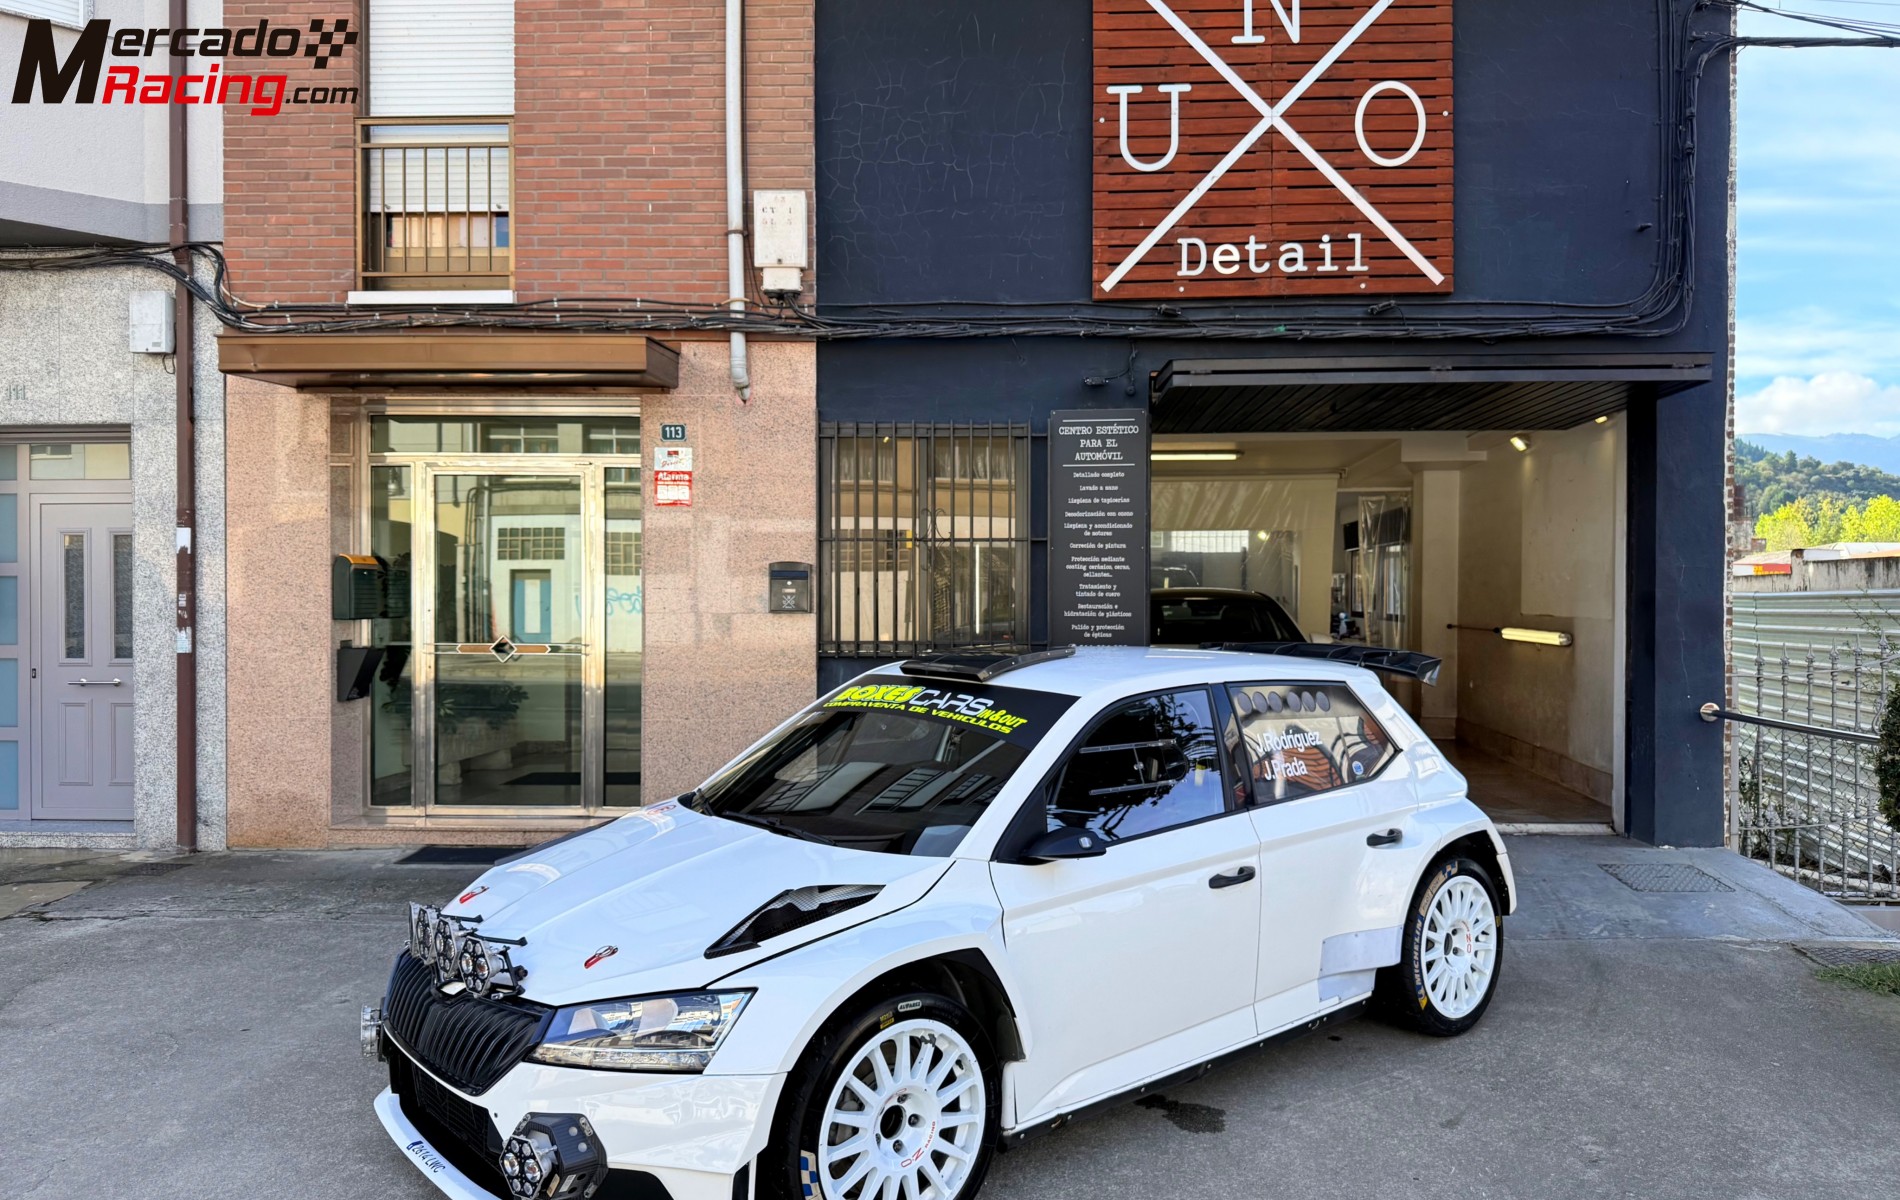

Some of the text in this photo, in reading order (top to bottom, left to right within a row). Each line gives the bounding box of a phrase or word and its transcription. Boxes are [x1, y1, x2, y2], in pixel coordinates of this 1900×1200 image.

[1176, 233, 1369, 277] Detail
[664, 426, 682, 438] 113
[1058, 423, 1140, 435] CENTRO ESTÉTICO
[1080, 439, 1118, 447] PARA EL
[1074, 449, 1123, 461] AUTOMÓVIL
[657, 472, 690, 481] Alarma
[822, 700, 1014, 734] COMPRAVENTA DE VEHICULOS
[1413, 918, 1423, 985] MICHELIN
[925, 1121, 936, 1149] RACING
[412, 1145, 433, 1161] 2614
